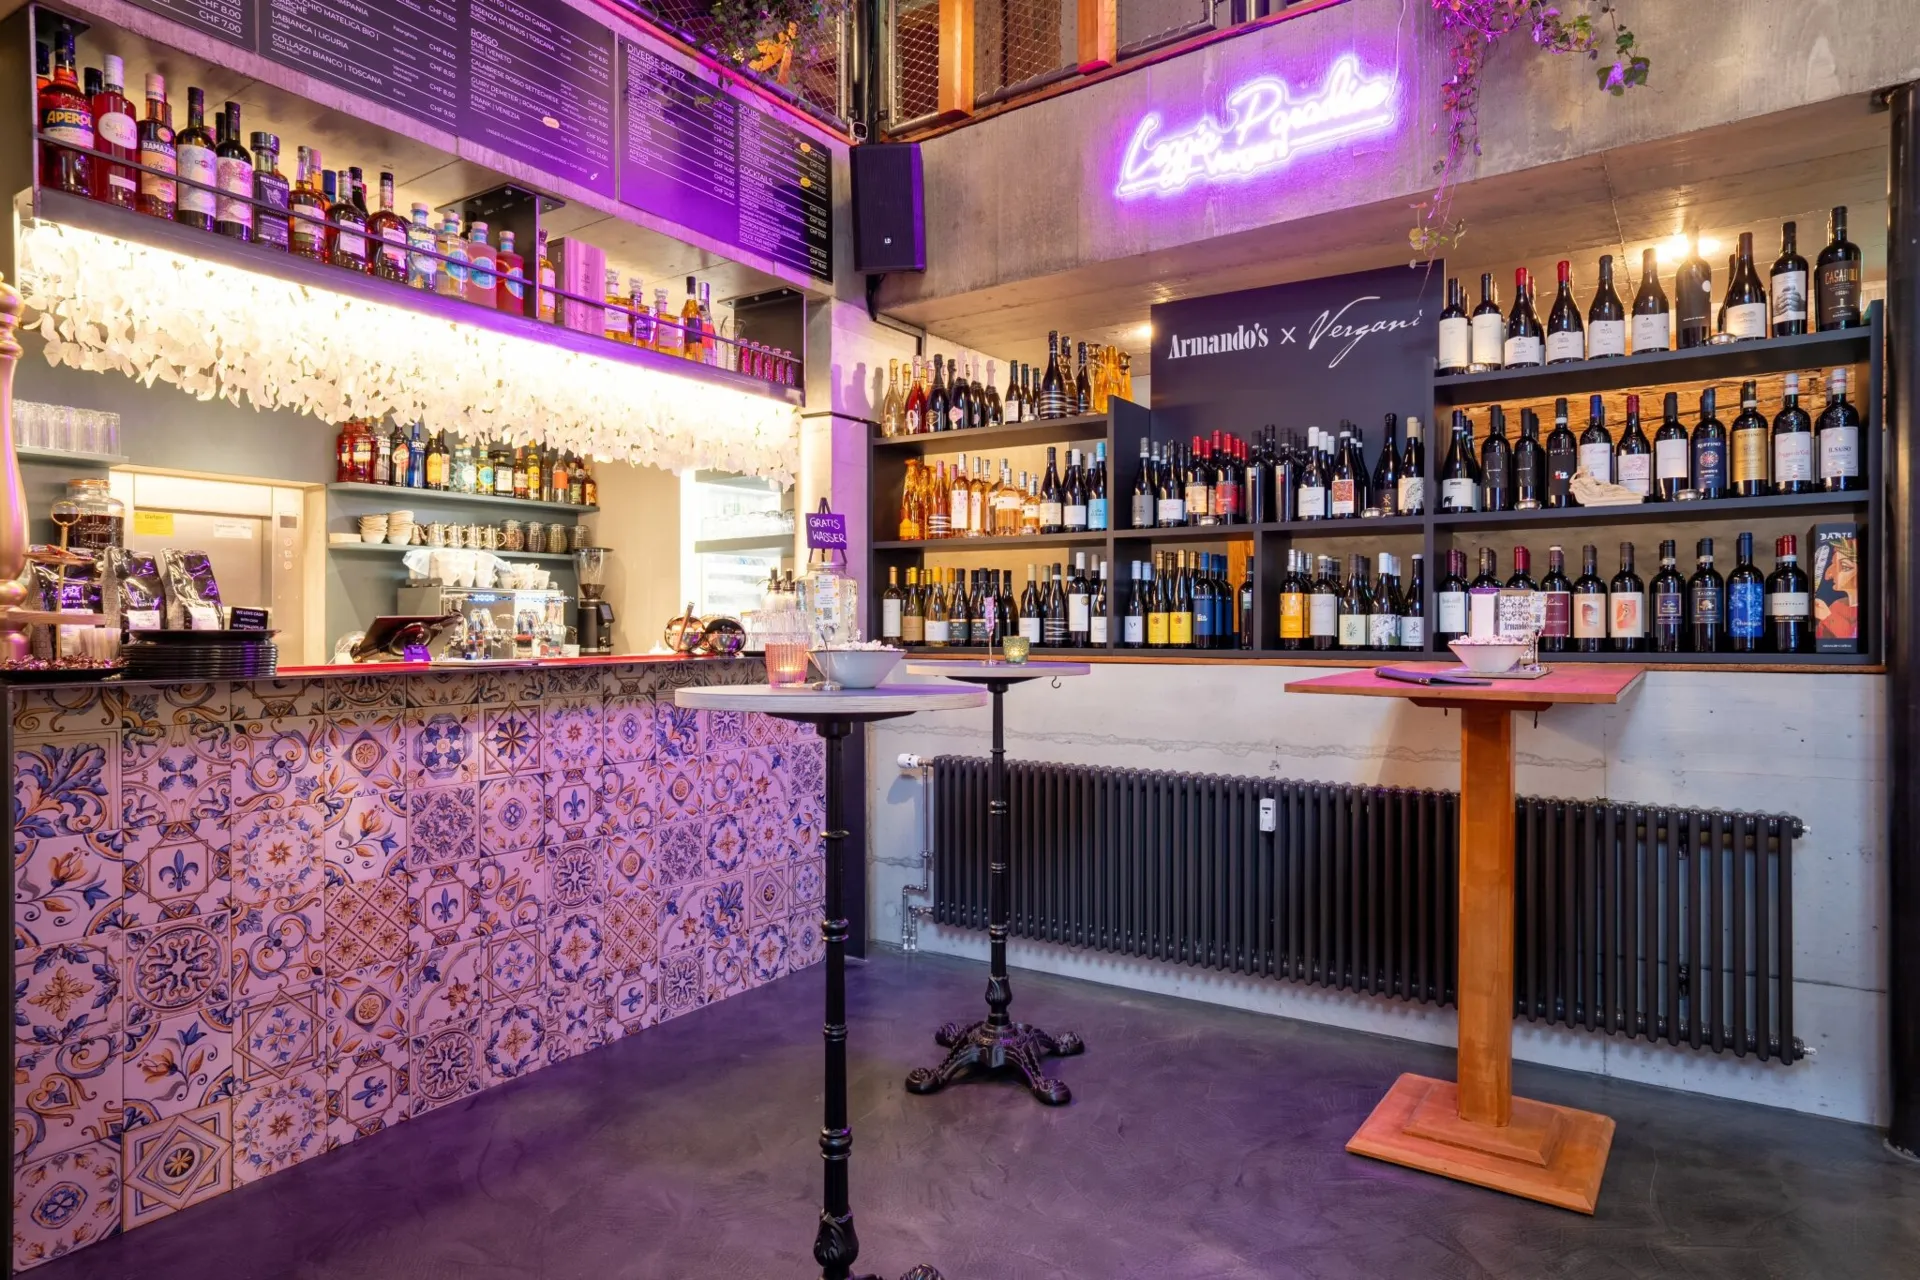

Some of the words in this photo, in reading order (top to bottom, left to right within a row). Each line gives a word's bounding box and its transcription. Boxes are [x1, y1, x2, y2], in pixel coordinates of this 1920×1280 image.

[198, 10, 222, 24] CHF
[222, 20, 242, 34] 7.00
[221, 6, 242, 20] 8.00
[323, 8, 360, 32] MATELICA
[362, 26, 375, 38] BIO
[272, 10, 312, 34] LABIANCA
[318, 30, 348, 50] LIGURIA
[470, 2, 496, 22] ESSENZA
[505, 20, 525, 37] VENUS
[529, 32, 554, 52] TOSCANA
[470, 27, 498, 48] ROSSO
[272, 32, 310, 55] COLLAZZI
[312, 49, 342, 68] BIANCO
[348, 64, 382, 85] TOSCANA
[429, 42, 441, 54] CHF
[442, 49, 455, 60] 8.00
[470, 38, 484, 51] DUE
[487, 46, 511, 64] VENETO
[627, 42, 658, 66] DIVERSE
[660, 60, 685, 81] SPRITZ
[429, 61, 442, 73] CHF
[429, 82, 441, 93] CHF
[429, 102, 442, 114] CHF
[471, 93, 491, 108] FRANK
[495, 104, 520, 121] VENEZIA
[46, 110, 92, 128] APEROL
[740, 163, 773, 186] COCKTAILS
[1168, 322, 1268, 360] Armando's
[1308, 296, 1423, 369] Vergani
[810, 516, 840, 530] GRATIS
[812, 531, 846, 543] WASSER
[1820, 532, 1852, 540] DANTE
